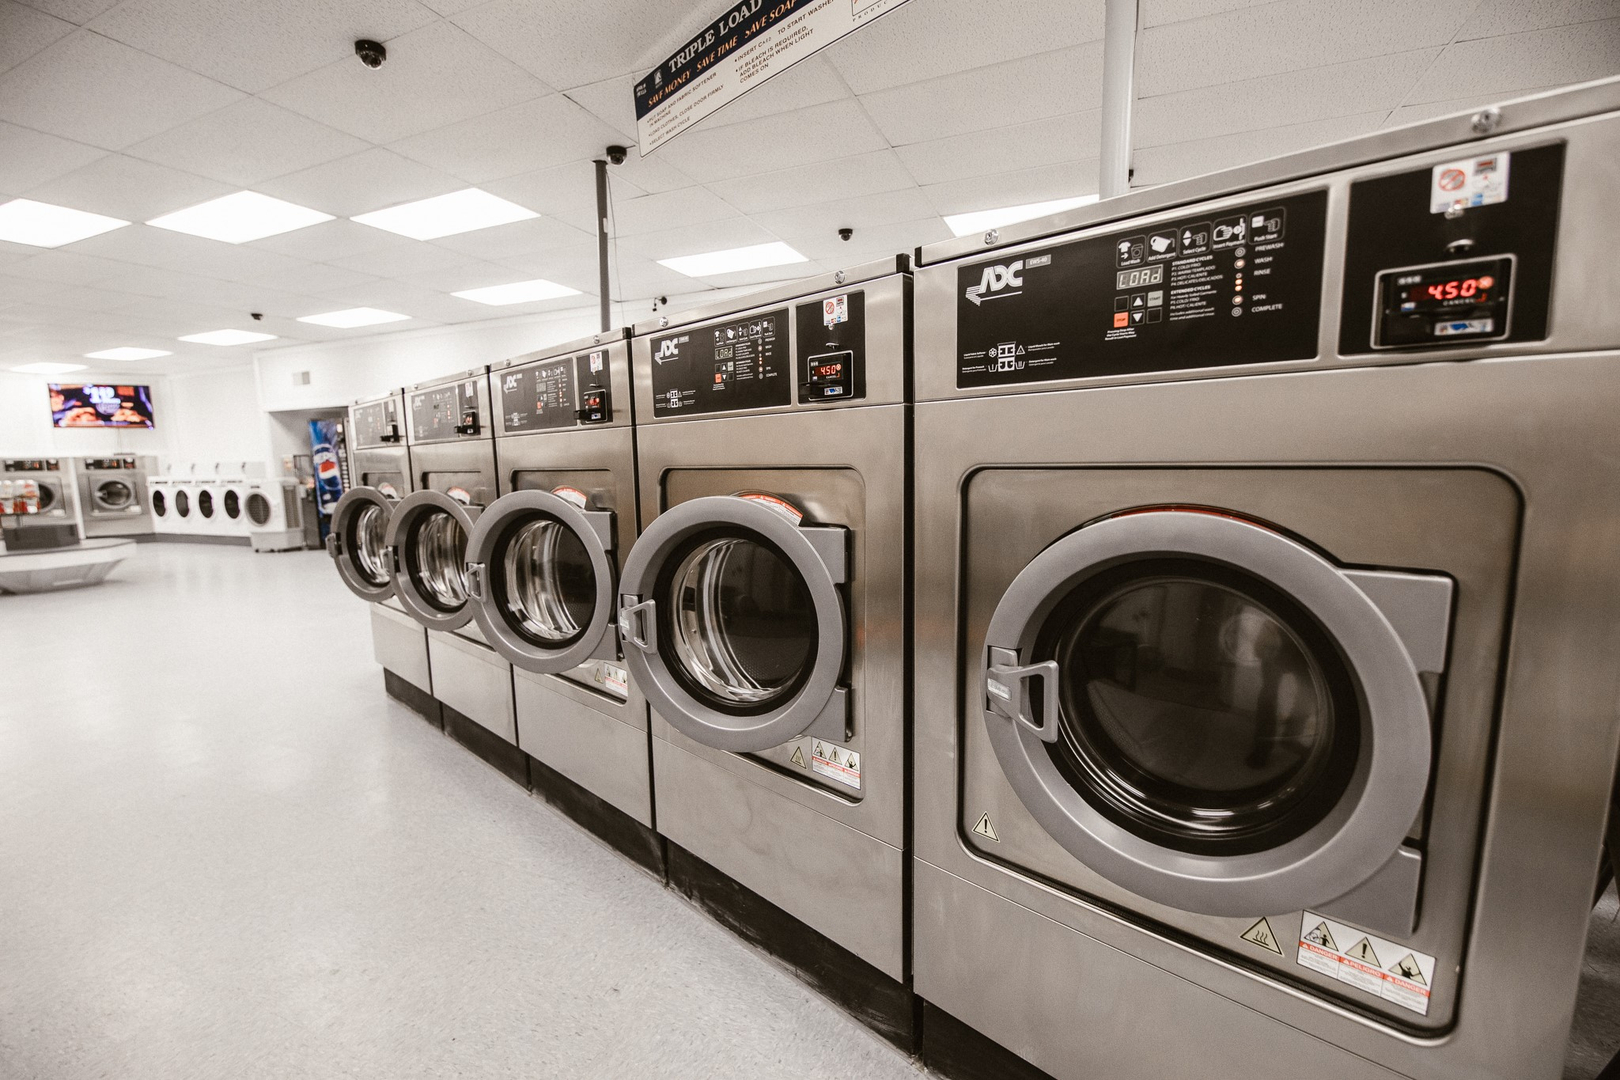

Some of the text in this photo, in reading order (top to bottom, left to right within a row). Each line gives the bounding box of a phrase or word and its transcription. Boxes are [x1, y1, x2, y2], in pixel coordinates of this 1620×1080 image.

[668, 0, 763, 73] TRIPLE LOAD
[737, 46, 758, 62] INSERT
[777, 27, 786, 35] TO
[787, 13, 807, 29] START
[664, 69, 692, 95] MONEY
[696, 51, 716, 72] SAVE
[717, 35, 738, 57] TIME
[744, 15, 768, 38] SAVE
[739, 28, 814, 77] ADD BLEACH WHEN LIGHT
[744, 50, 767, 67] BLEACH
[692, 72, 717, 92] SOFTENER
[739, 62, 769, 84] COMES ON
[1254, 256, 1273, 264] WASH
[979, 260, 1024, 293] ADC
[1253, 268, 1271, 276] RINSE
[1251, 303, 1283, 313] COMPLETE
[660, 337, 679, 358] ADC
[1309, 945, 1339, 961] DANGER
[1349, 961, 1382, 977] PELIGRO
[1394, 978, 1427, 996] DANGER
